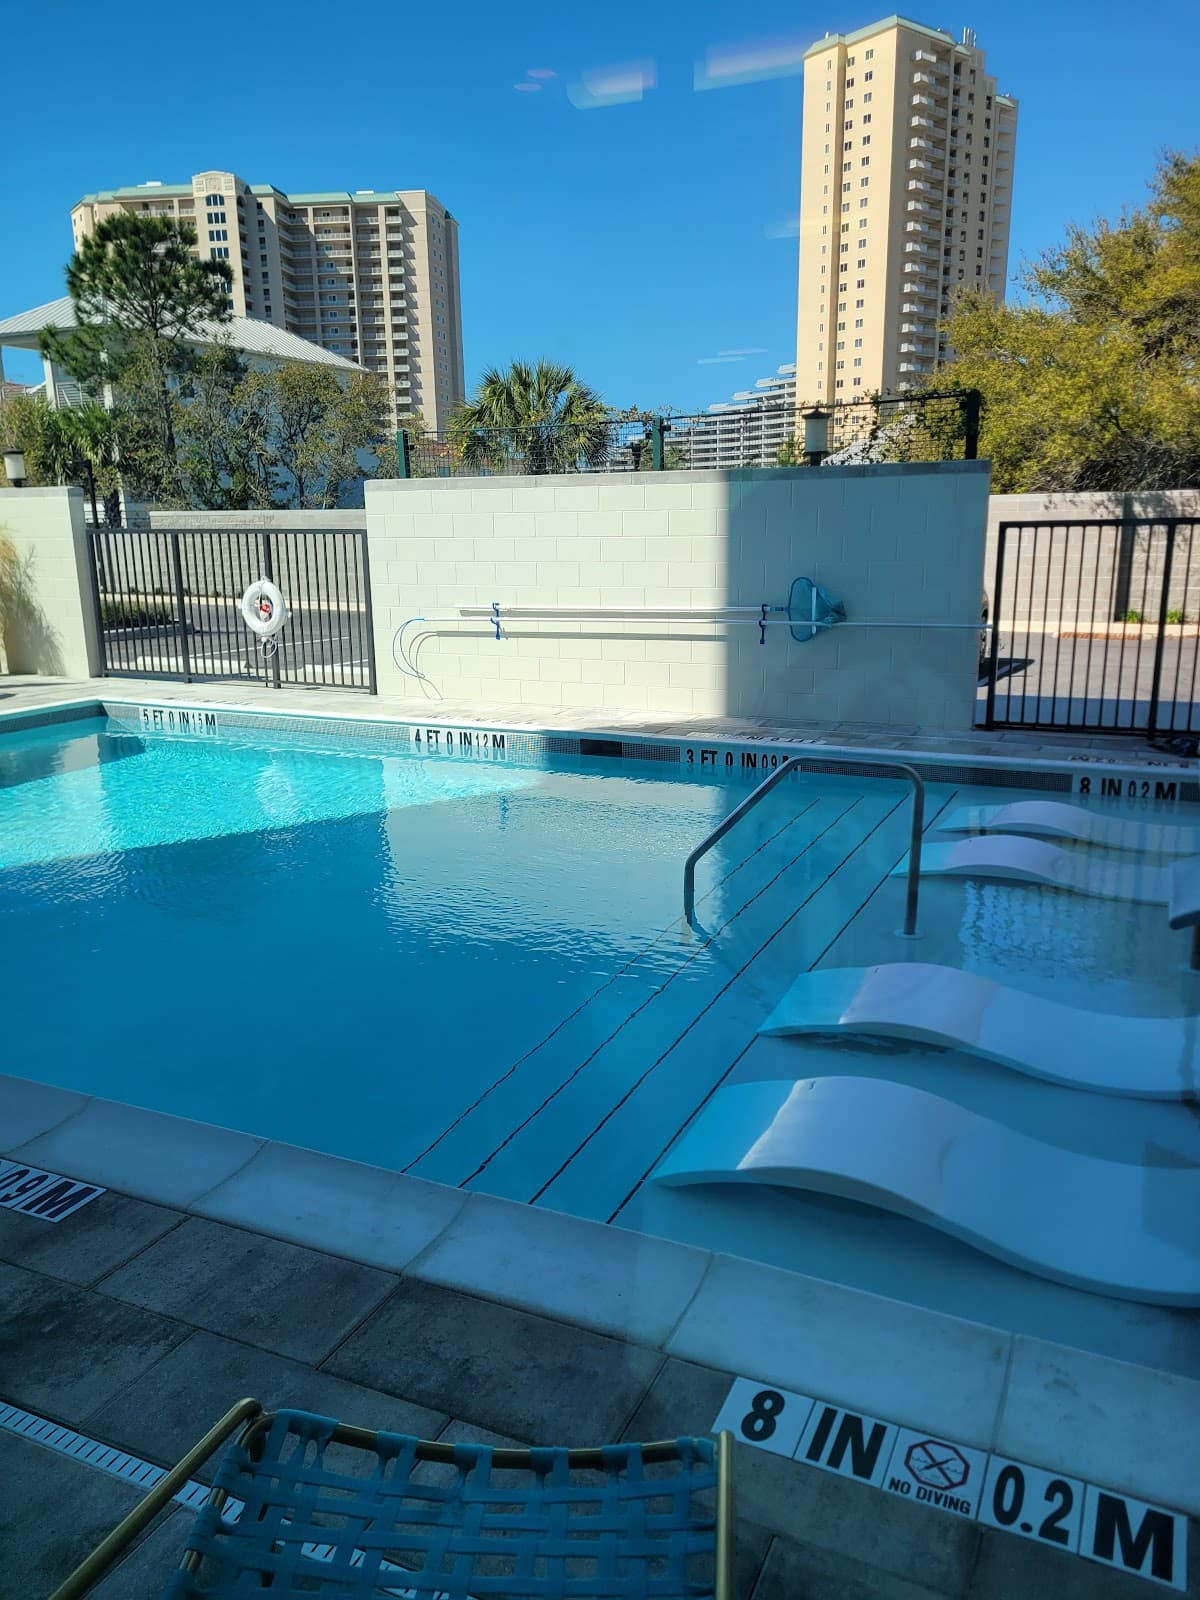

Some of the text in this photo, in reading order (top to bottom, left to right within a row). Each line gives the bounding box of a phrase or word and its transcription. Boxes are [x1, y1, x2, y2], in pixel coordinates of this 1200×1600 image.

[415, 728, 422, 742] 4
[426, 729, 440, 744] FT
[460, 731, 472, 746] IN
[492, 734, 505, 749] M
[686, 749, 694, 764] 3
[700, 749, 718, 765] FT
[725, 751, 734, 766] 0
[741, 752, 757, 769] IN
[1080, 776, 1091, 794] 8
[1101, 778, 1122, 797] IN
[1155, 781, 1177, 800] M
[19, 1180, 98, 1219] M
[741, 1390, 1174, 1583] 8 IN 0.2 M
[888, 1477, 971, 1515] NO DIVING
